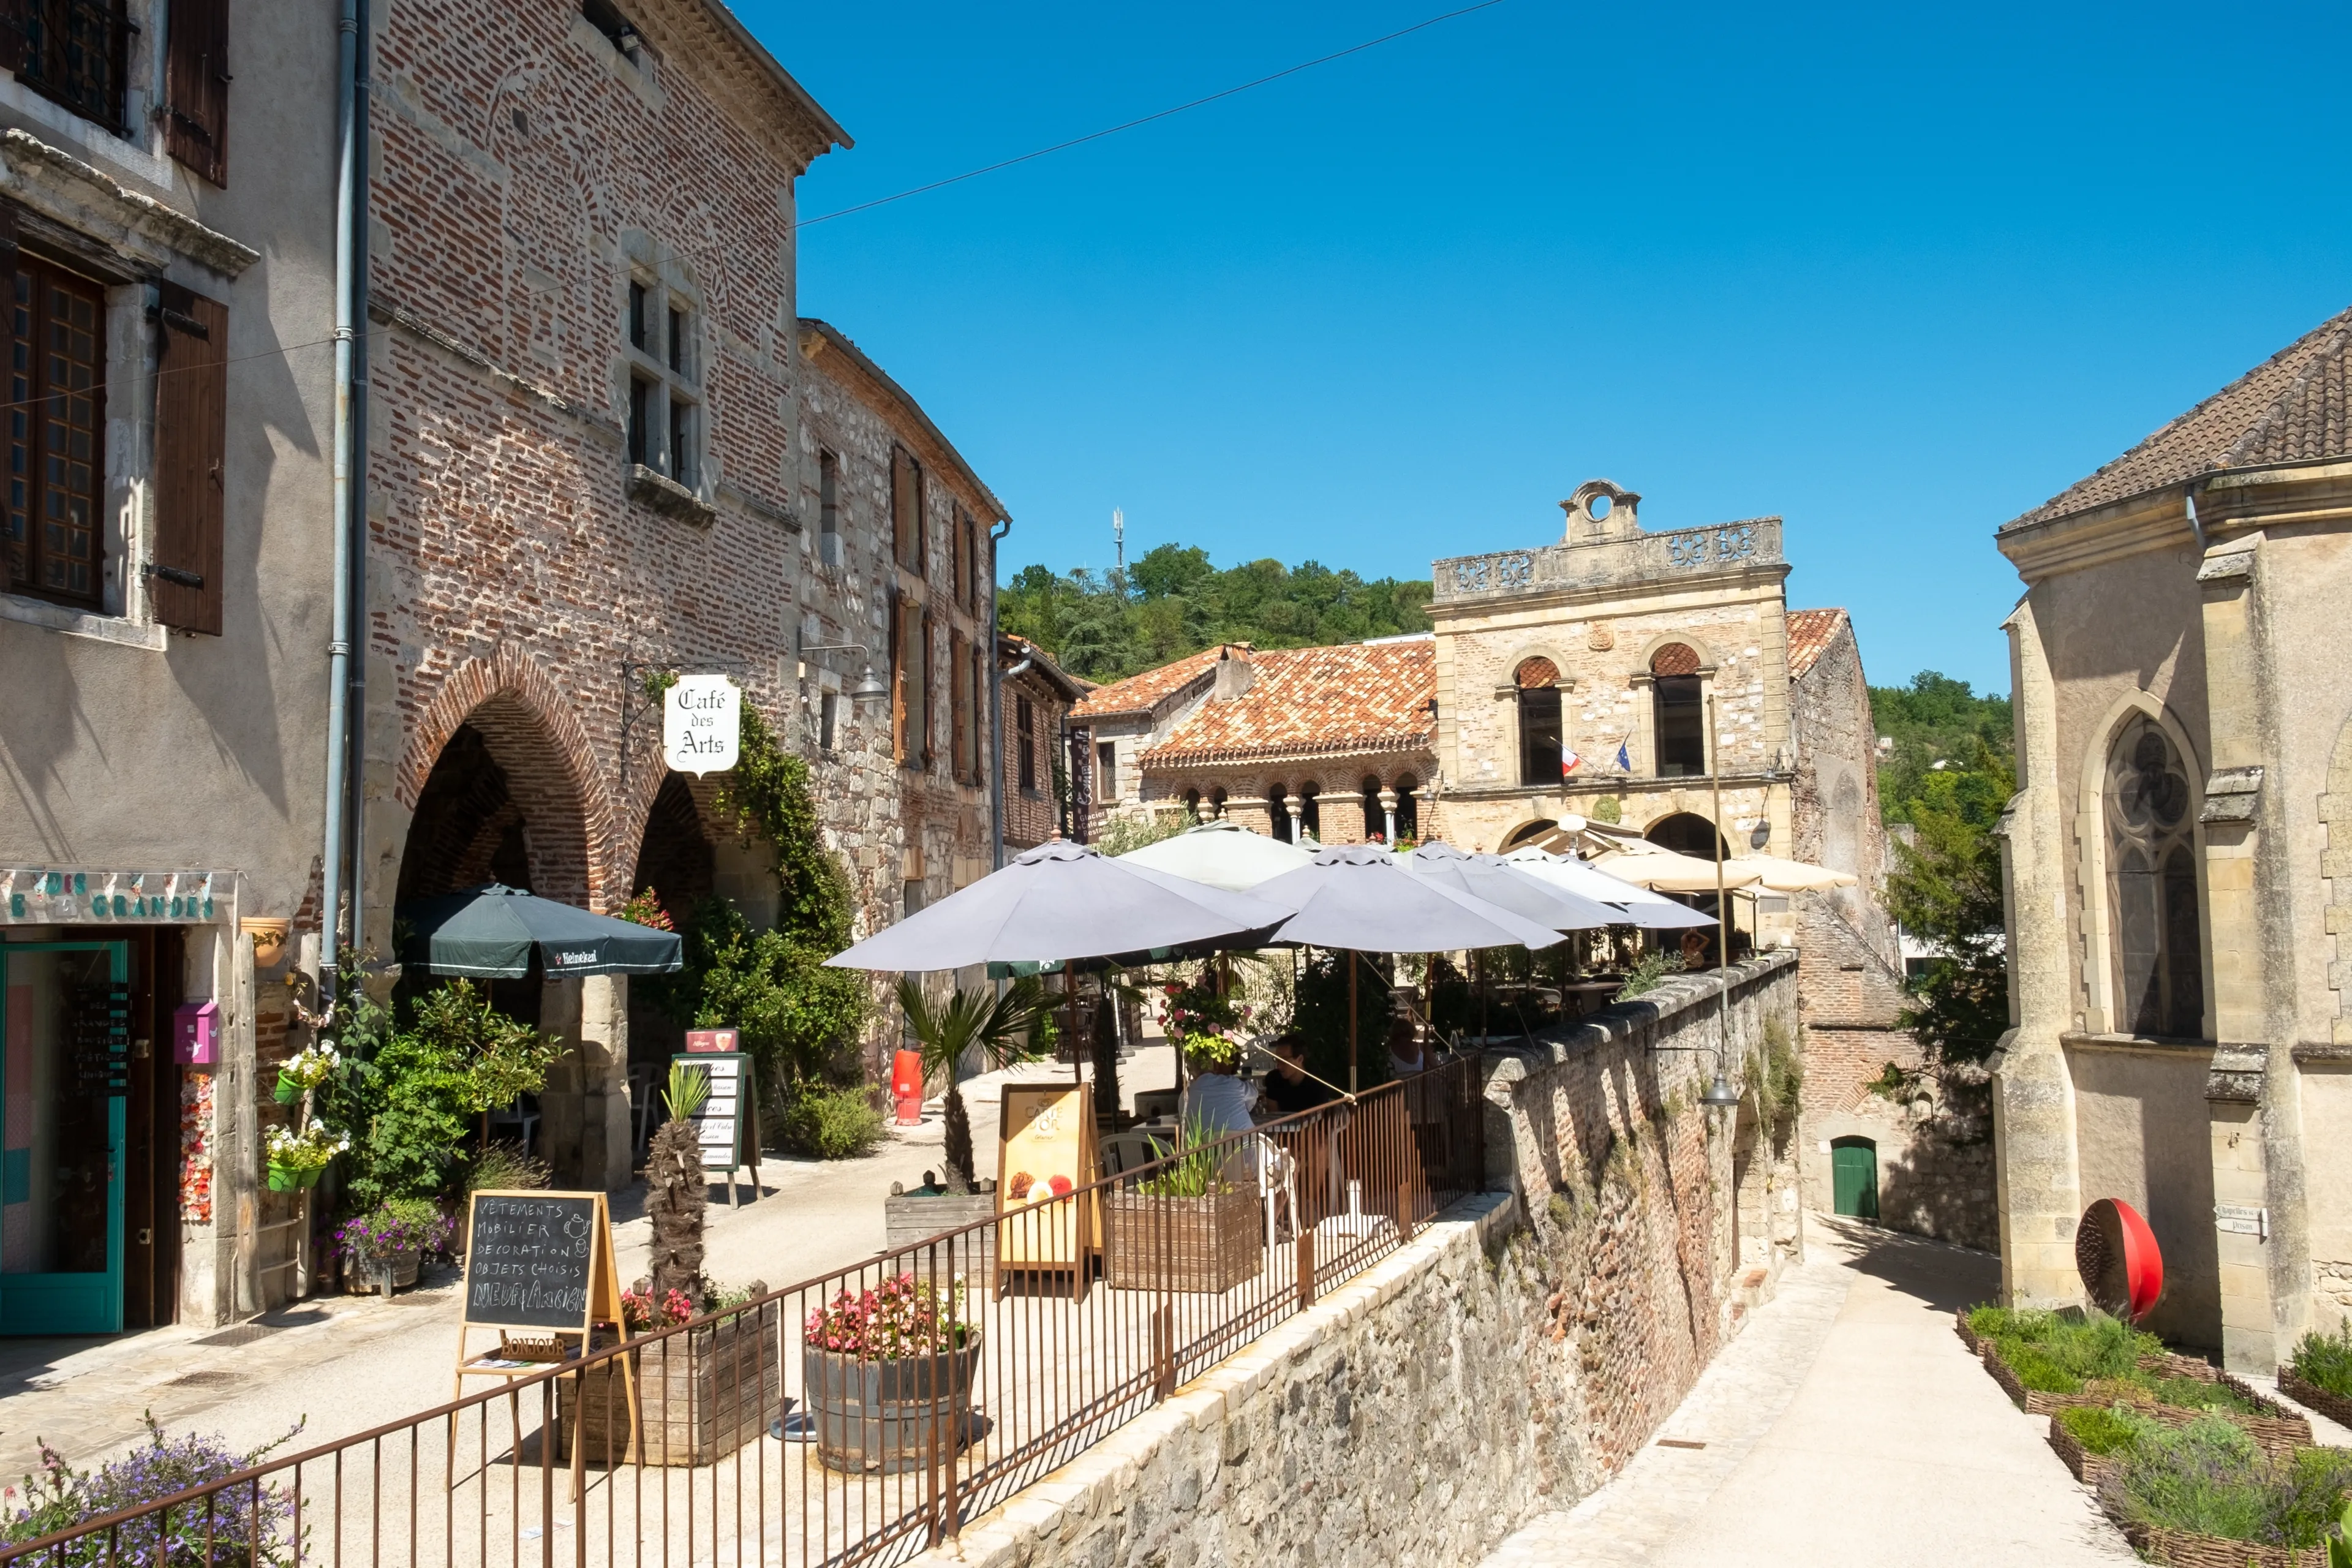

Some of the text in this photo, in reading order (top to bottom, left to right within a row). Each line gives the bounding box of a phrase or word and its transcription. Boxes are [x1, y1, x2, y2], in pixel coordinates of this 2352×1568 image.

[678, 688, 725, 709] Café
[691, 714, 714, 727] des
[677, 731, 725, 763] Arts
[1080, 811, 1105, 821] Glacier
[1082, 820, 1097, 829] Café
[92, 894, 213, 917] GRANDES
[562, 949, 597, 964] Heineken
[1025, 1106, 1063, 1120] CARTE
[479, 1199, 563, 1218] VÊTEMENTS
[2233, 1220, 2253, 1230] Prison
[475, 1262, 526, 1276] OBJETS
[501, 1338, 566, 1355] BONJOUR
